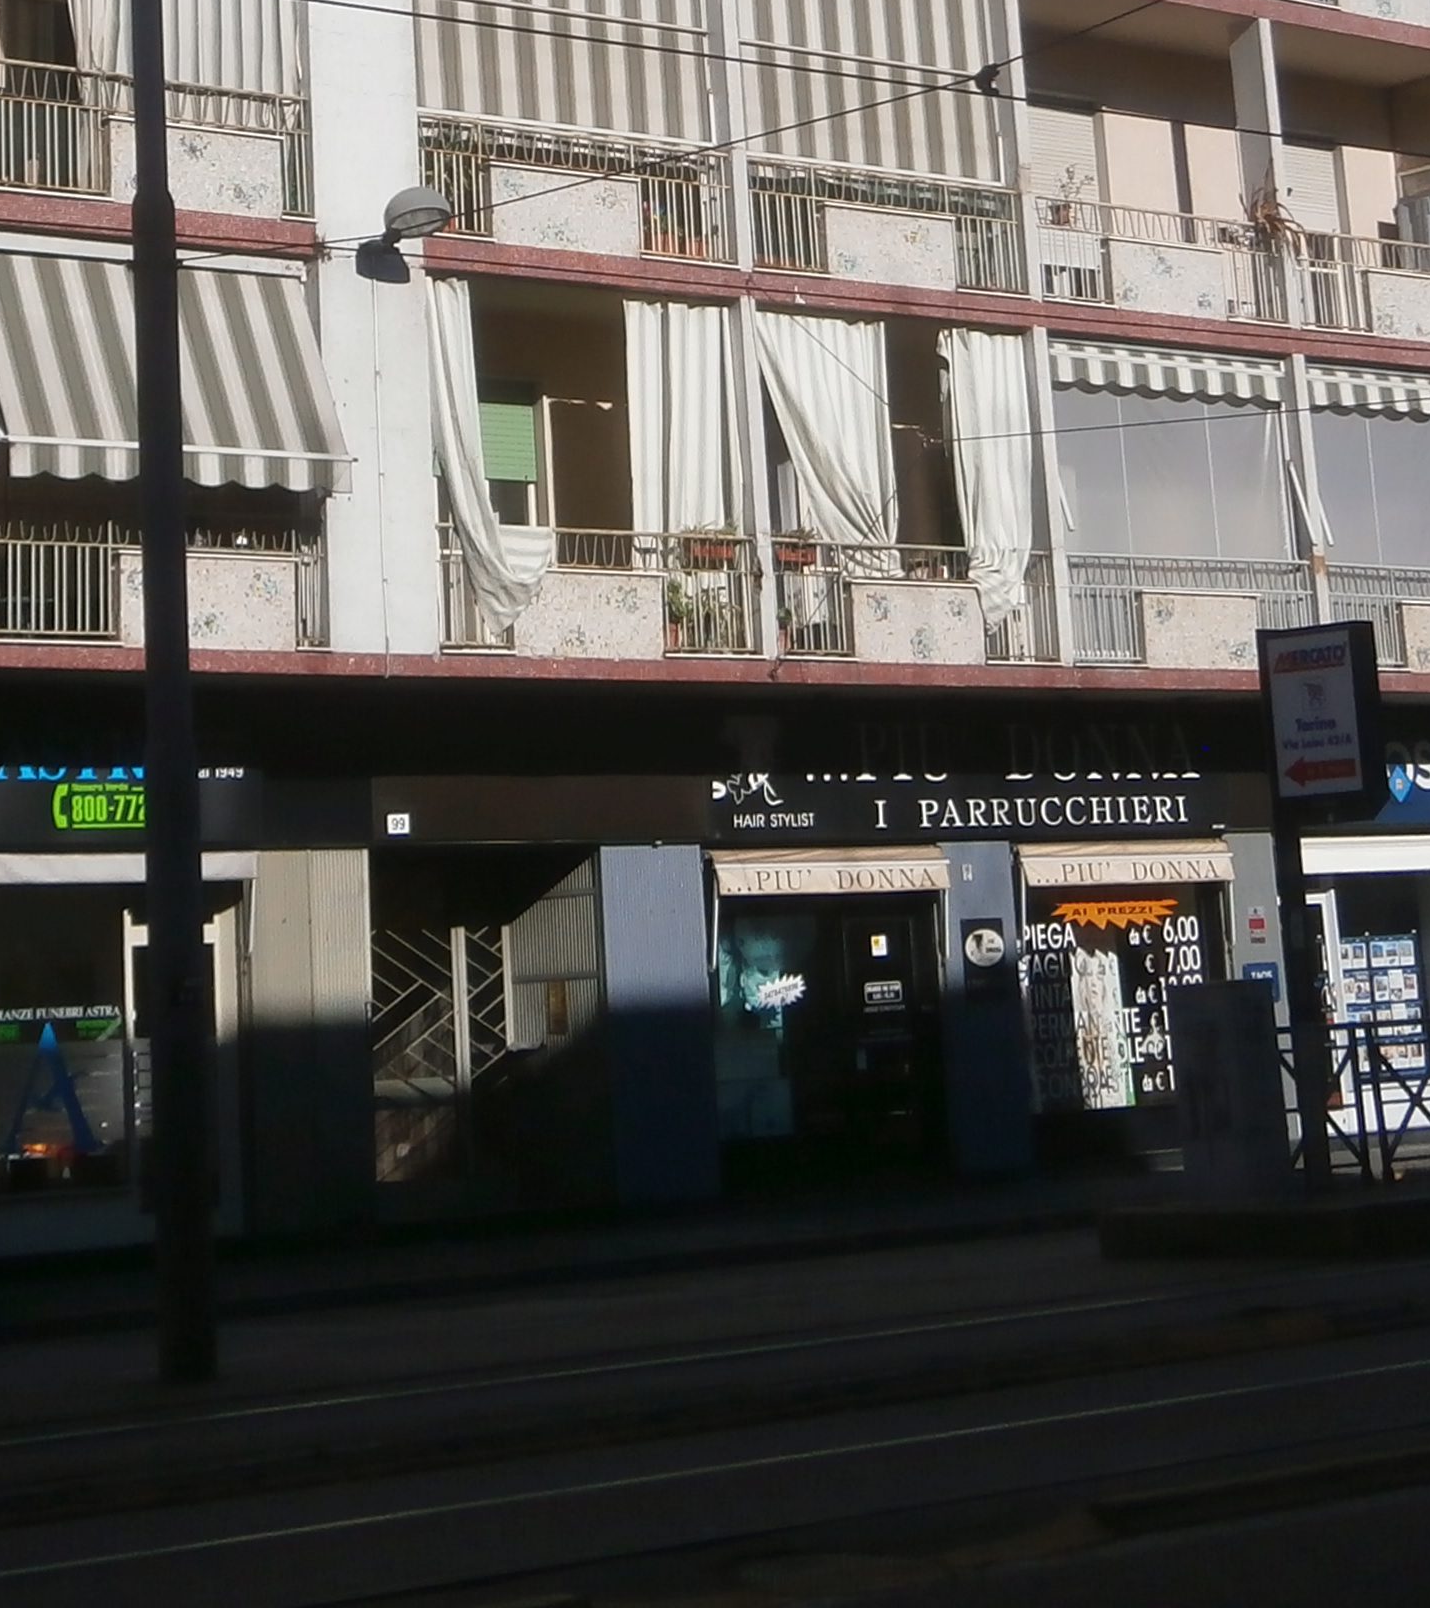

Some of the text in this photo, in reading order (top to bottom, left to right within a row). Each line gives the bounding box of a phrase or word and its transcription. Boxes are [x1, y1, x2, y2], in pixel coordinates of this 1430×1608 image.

[1295, 716, 1337, 731] Torino
[1004, 722, 1202, 782] DONNA
[732, 811, 815, 830] HAIR STYLIST
[874, 794, 1190, 830] I PARRUCCHIERI
[837, 867, 938, 890] DONNA
[1131, 860, 1221, 881] DONNA
[1072, 906, 1154, 917] AI PREZZI
[1024, 922, 1077, 951] PIEGA
[1162, 915, 1200, 945] 6,00
[1164, 945, 1202, 973] 7,00
[36, 1006, 84, 1020] FUNEBRI
[85, 1004, 121, 1018] ASTRA
